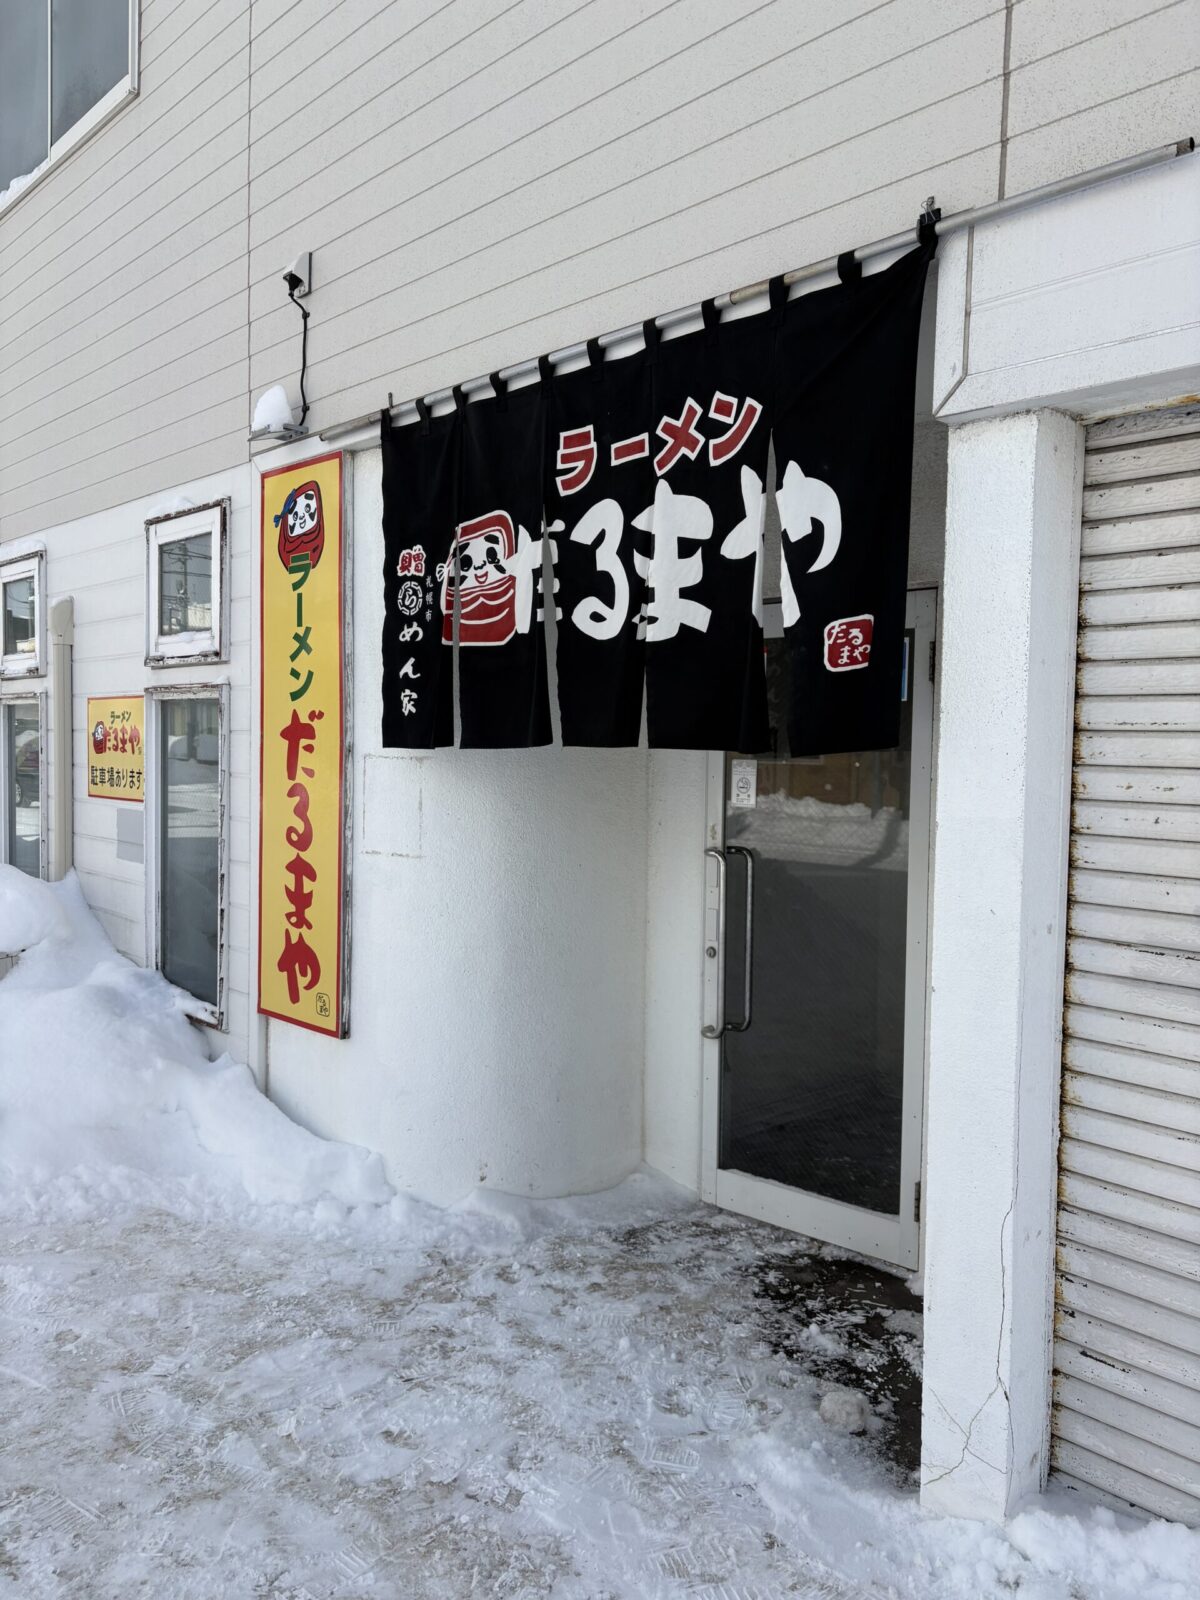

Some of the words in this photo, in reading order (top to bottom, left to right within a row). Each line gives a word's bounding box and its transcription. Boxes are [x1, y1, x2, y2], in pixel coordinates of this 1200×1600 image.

[555, 390, 763, 497] ラーメン
[504, 459, 842, 642] だるまや
[288, 552, 313, 702] ラーメン
[102, 723, 140, 755] だるまや
[110, 710, 131, 725] ラーメン
[90, 765, 143, 790] 駐車場あります
[277, 708, 325, 1004] だるまや
